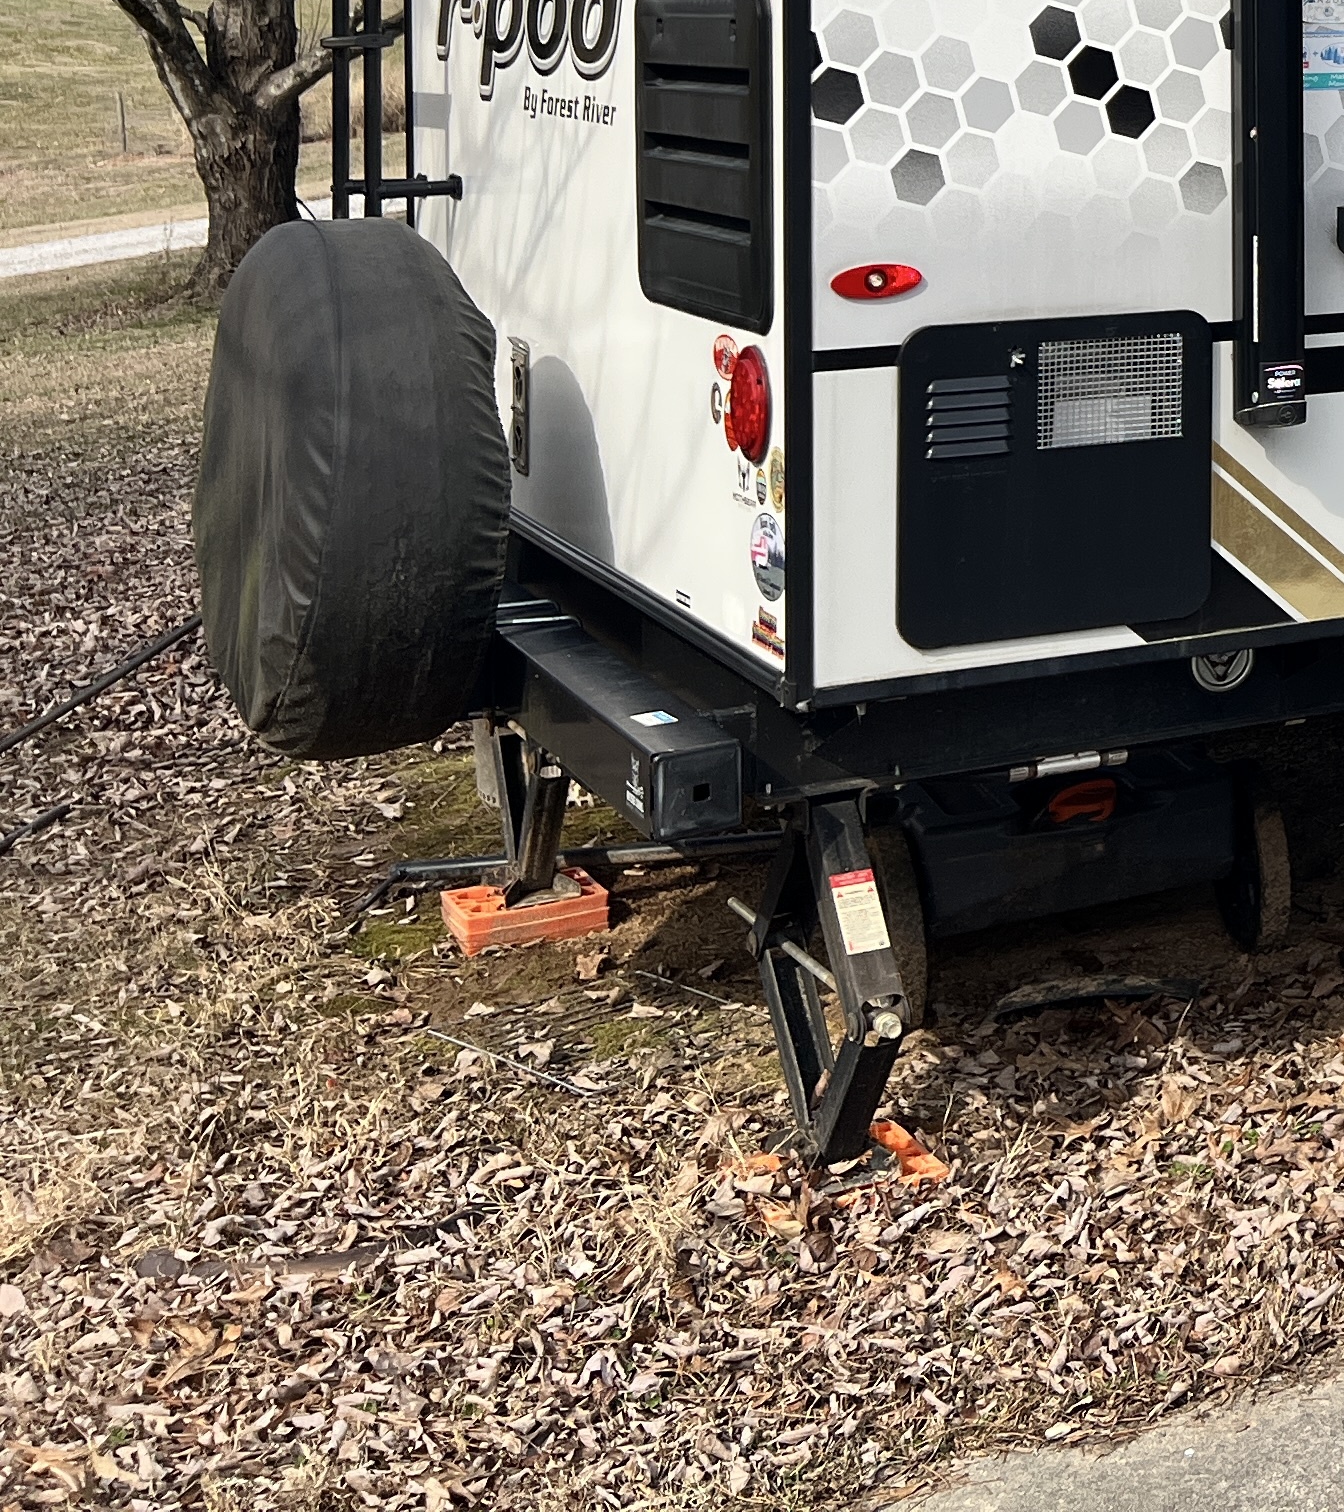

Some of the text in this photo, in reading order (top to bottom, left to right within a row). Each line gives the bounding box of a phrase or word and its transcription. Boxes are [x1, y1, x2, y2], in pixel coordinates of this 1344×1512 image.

[523, 86, 617, 126] By Forest River
